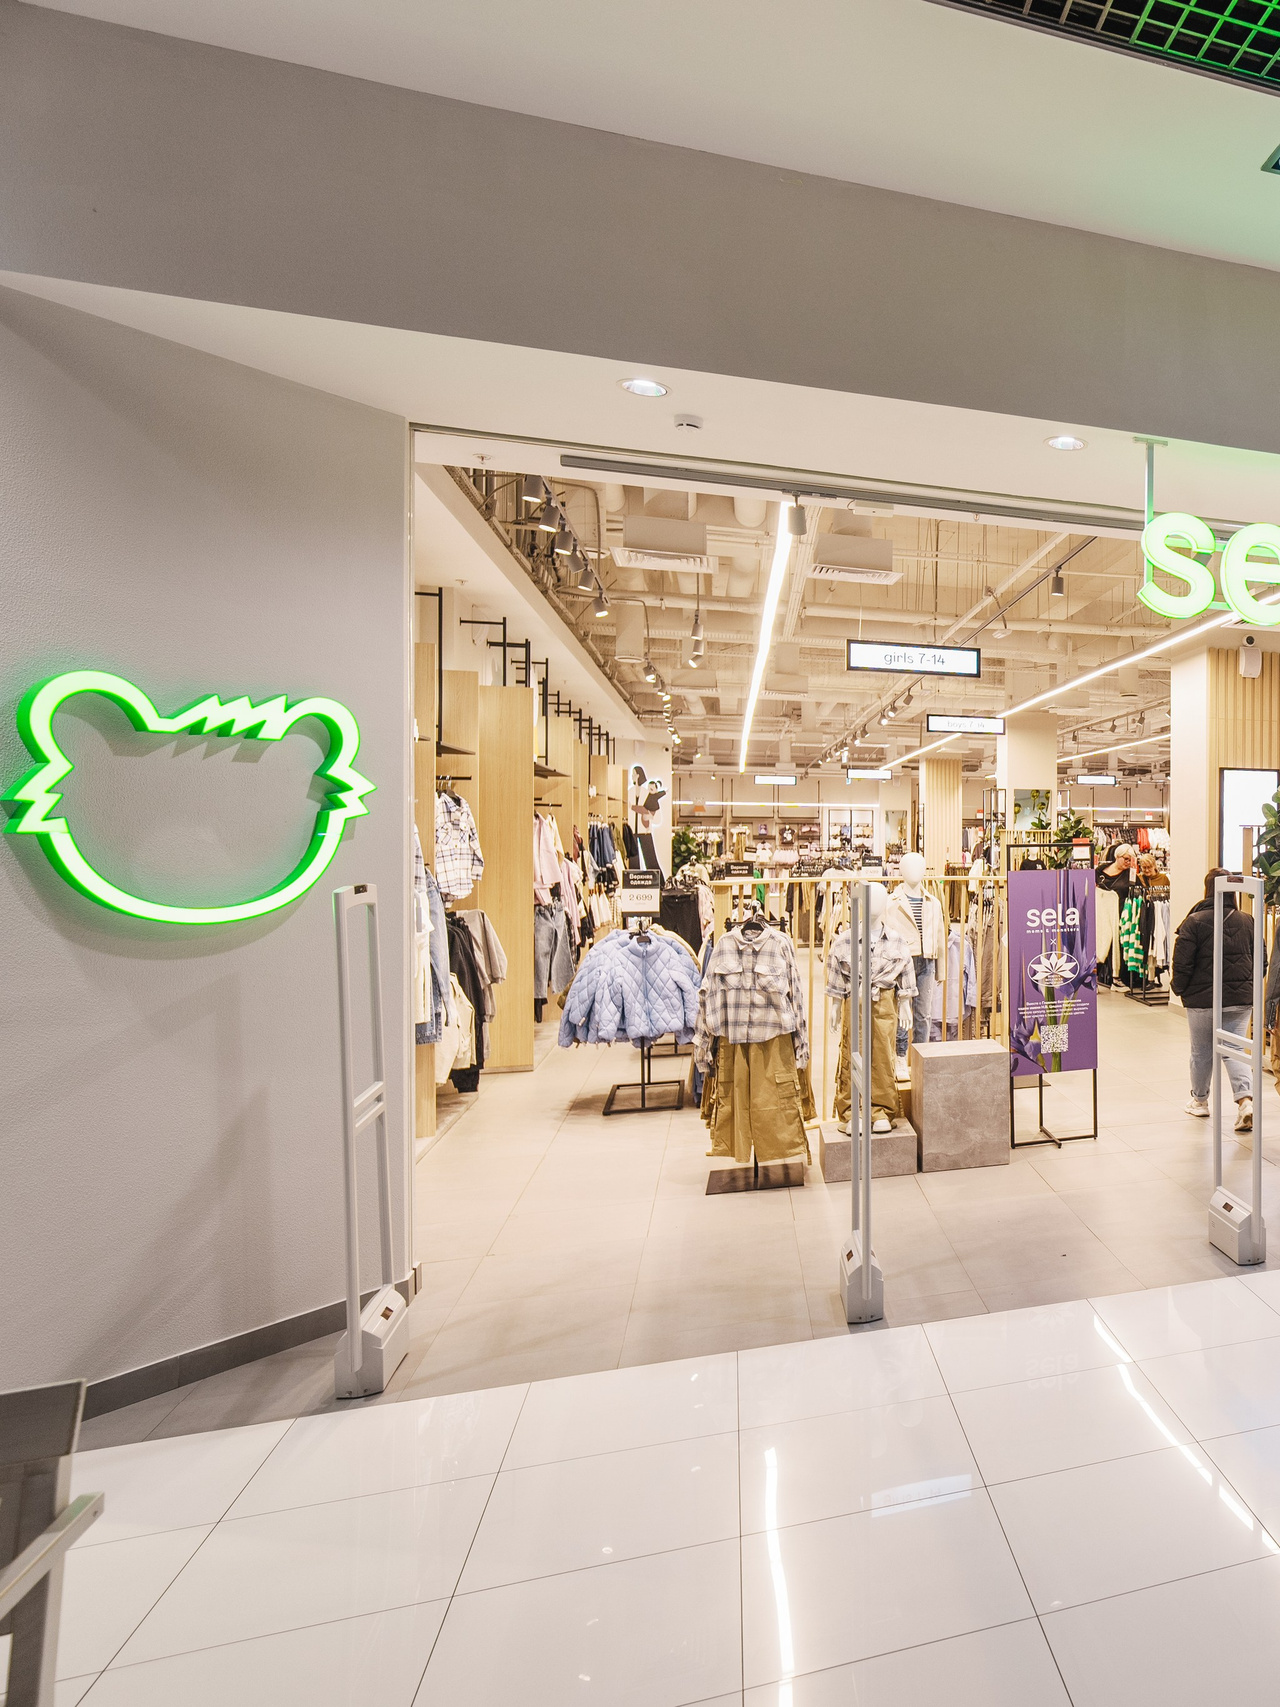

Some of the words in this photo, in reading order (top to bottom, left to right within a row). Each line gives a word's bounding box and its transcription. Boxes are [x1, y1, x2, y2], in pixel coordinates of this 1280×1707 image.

[884, 652, 914, 665] girls
[918, 652, 945, 666] 7-14
[1026, 903, 1080, 928] sela
